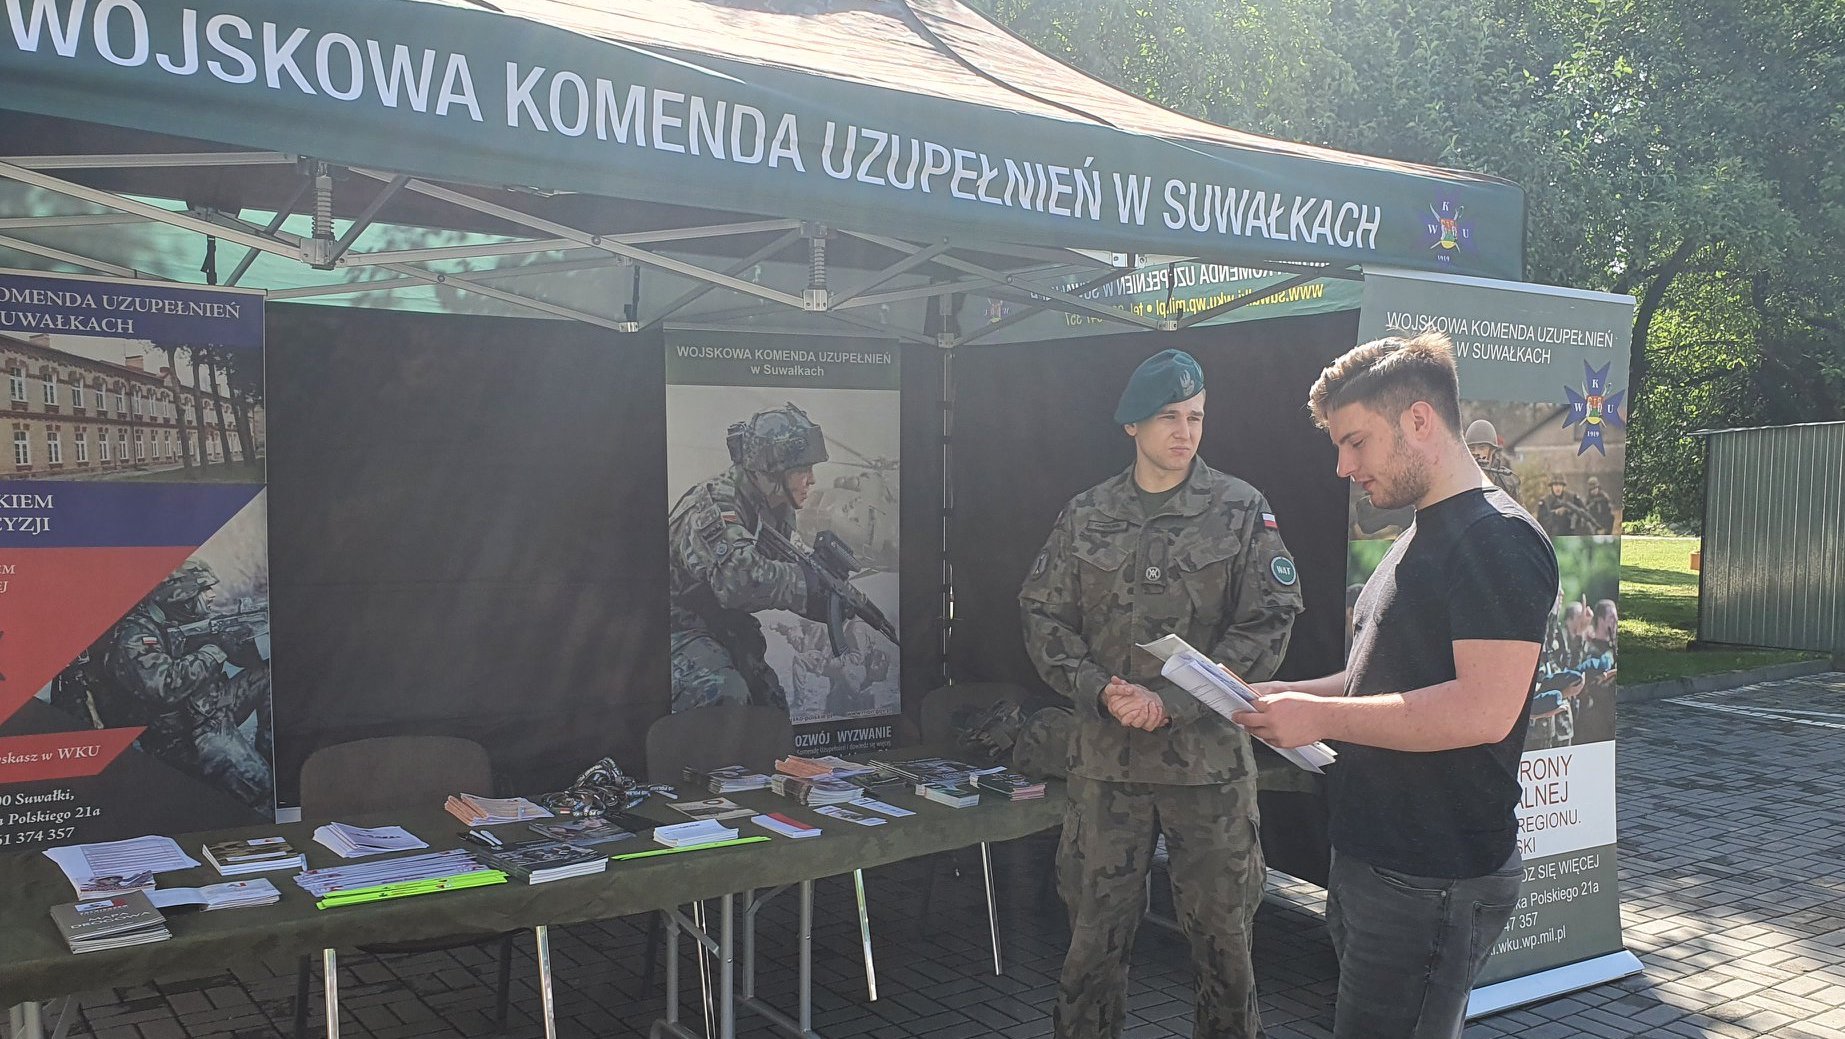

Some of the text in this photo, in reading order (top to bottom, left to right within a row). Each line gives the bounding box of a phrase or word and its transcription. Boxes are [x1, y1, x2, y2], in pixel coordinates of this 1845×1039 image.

[6, 0, 1381, 250] WOJSKOWA KOMENDA UZUPEŁNIEŃ W SUWAŁKACH
[1442, 201, 1450, 211] K
[1428, 224, 1469, 239] W U
[102, 295, 241, 320] UZUPEŁNIEŃ
[1387, 311, 1613, 348] WOJSKOWA KOMENDA UZUPEŁNIEŃ
[677, 345, 892, 365] WOJSKOWA KOMENDA UZUPEŁNIEŃ
[1456, 341, 1551, 365] W SUWAŁKACH
[751, 365, 825, 377] w Suwałkach
[1592, 379, 1599, 388] K
[1574, 402, 1614, 413] W U
[0, 517, 51, 535] YZJI
[837, 726, 892, 743] WYZWANIE
[0, 745, 100, 765] skasz w WKU
[15, 789, 75, 806] Suwałki,
[1519, 781, 1568, 809] LNEJ
[8, 810, 71, 824] Polskiego
[75, 806, 100, 819] 21a
[16, 830, 43, 844] 374
[47, 827, 75, 841] 357
[1538, 862, 1556, 880] SIĘ
[1559, 851, 1600, 875] WIĘCEJ
[1530, 886, 1579, 907] Polskiego
[1581, 881, 1599, 897] 21a
[1518, 911, 1539, 929] 357
